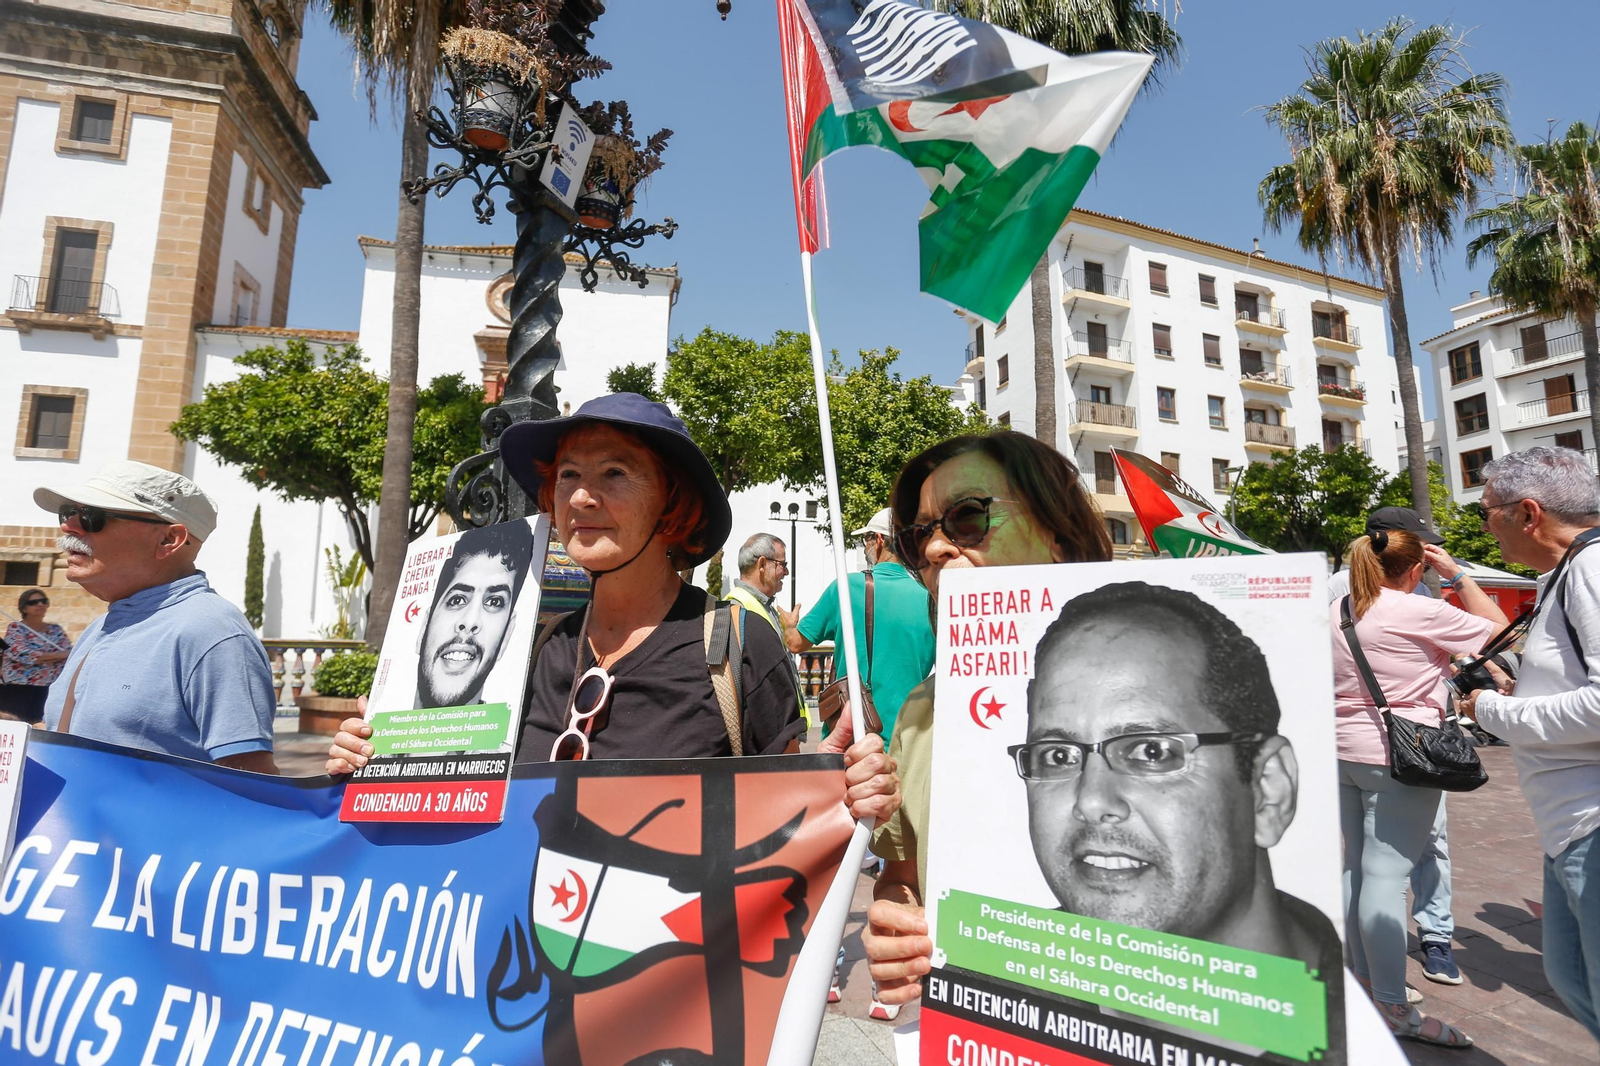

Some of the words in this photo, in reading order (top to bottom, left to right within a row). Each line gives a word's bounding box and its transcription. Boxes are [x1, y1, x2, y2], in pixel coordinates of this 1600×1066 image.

[408, 547, 444, 568] LIBERAR
[446, 545, 452, 558] A
[405, 564, 435, 583] CHEIKH
[1248, 576, 1312, 585] RÉPUBLIQUE
[401, 580, 429, 599] BANGA
[949, 589, 1031, 618] LIBERAR
[1040, 587, 1053, 612] A
[950, 617, 1019, 647] NAÂMA
[389, 714, 417, 723] Miembro
[419, 713, 428, 721] de
[429, 712, 435, 720] la
[436, 710, 468, 720] Comisión
[469, 710, 486, 720] para
[9, 734, 14, 748] A
[374, 729, 380, 737] la
[381, 728, 408, 737] Defensa
[409, 726, 418, 735] de
[418, 726, 429, 734] los
[430, 724, 463, 734] Derechos
[464, 722, 499, 732] Humanos
[401, 740, 408, 748] el
[408, 739, 433, 748] Sáhara
[434, 736, 473, 747] Occidental
[363, 761, 401, 778] DETENCIÓN
[400, 761, 444, 777] ARBITRARIA
[445, 761, 456, 776] EN
[457, 760, 506, 775] MARRUECOS
[353, 792, 422, 812] CONDENADO
[422, 792, 432, 812] A
[434, 792, 451, 812] 30
[452, 788, 488, 812] AÑOS
[92, 847, 161, 937] LA
[172, 861, 483, 998] LIBERACIÓN
[980, 903, 1065, 936] Presidente
[1069, 924, 1092, 941] de
[1096, 928, 1112, 946] la
[1116, 933, 1204, 966] Comisión
[1208, 957, 1258, 979] para
[958, 921, 973, 937] la
[976, 925, 1041, 954] Defensa
[1044, 942, 1067, 961] de
[1070, 947, 1096, 968] los
[1100, 954, 1188, 990] Derechos
[1192, 976, 1296, 1017] Humanos
[1005, 961, 1026, 977] en
[1029, 964, 1046, 981] el
[1048, 966, 1110, 998] Sáhara
[1112, 984, 1220, 1027] Occidental
[140, 984, 221, 1066] EN
[929, 977, 949, 1003] EN
[952, 989, 1040, 1031] DETENCIÓN
[1044, 1012, 1157, 1066] ARBITRARIA
[1162, 1043, 1189, 1066] EN
